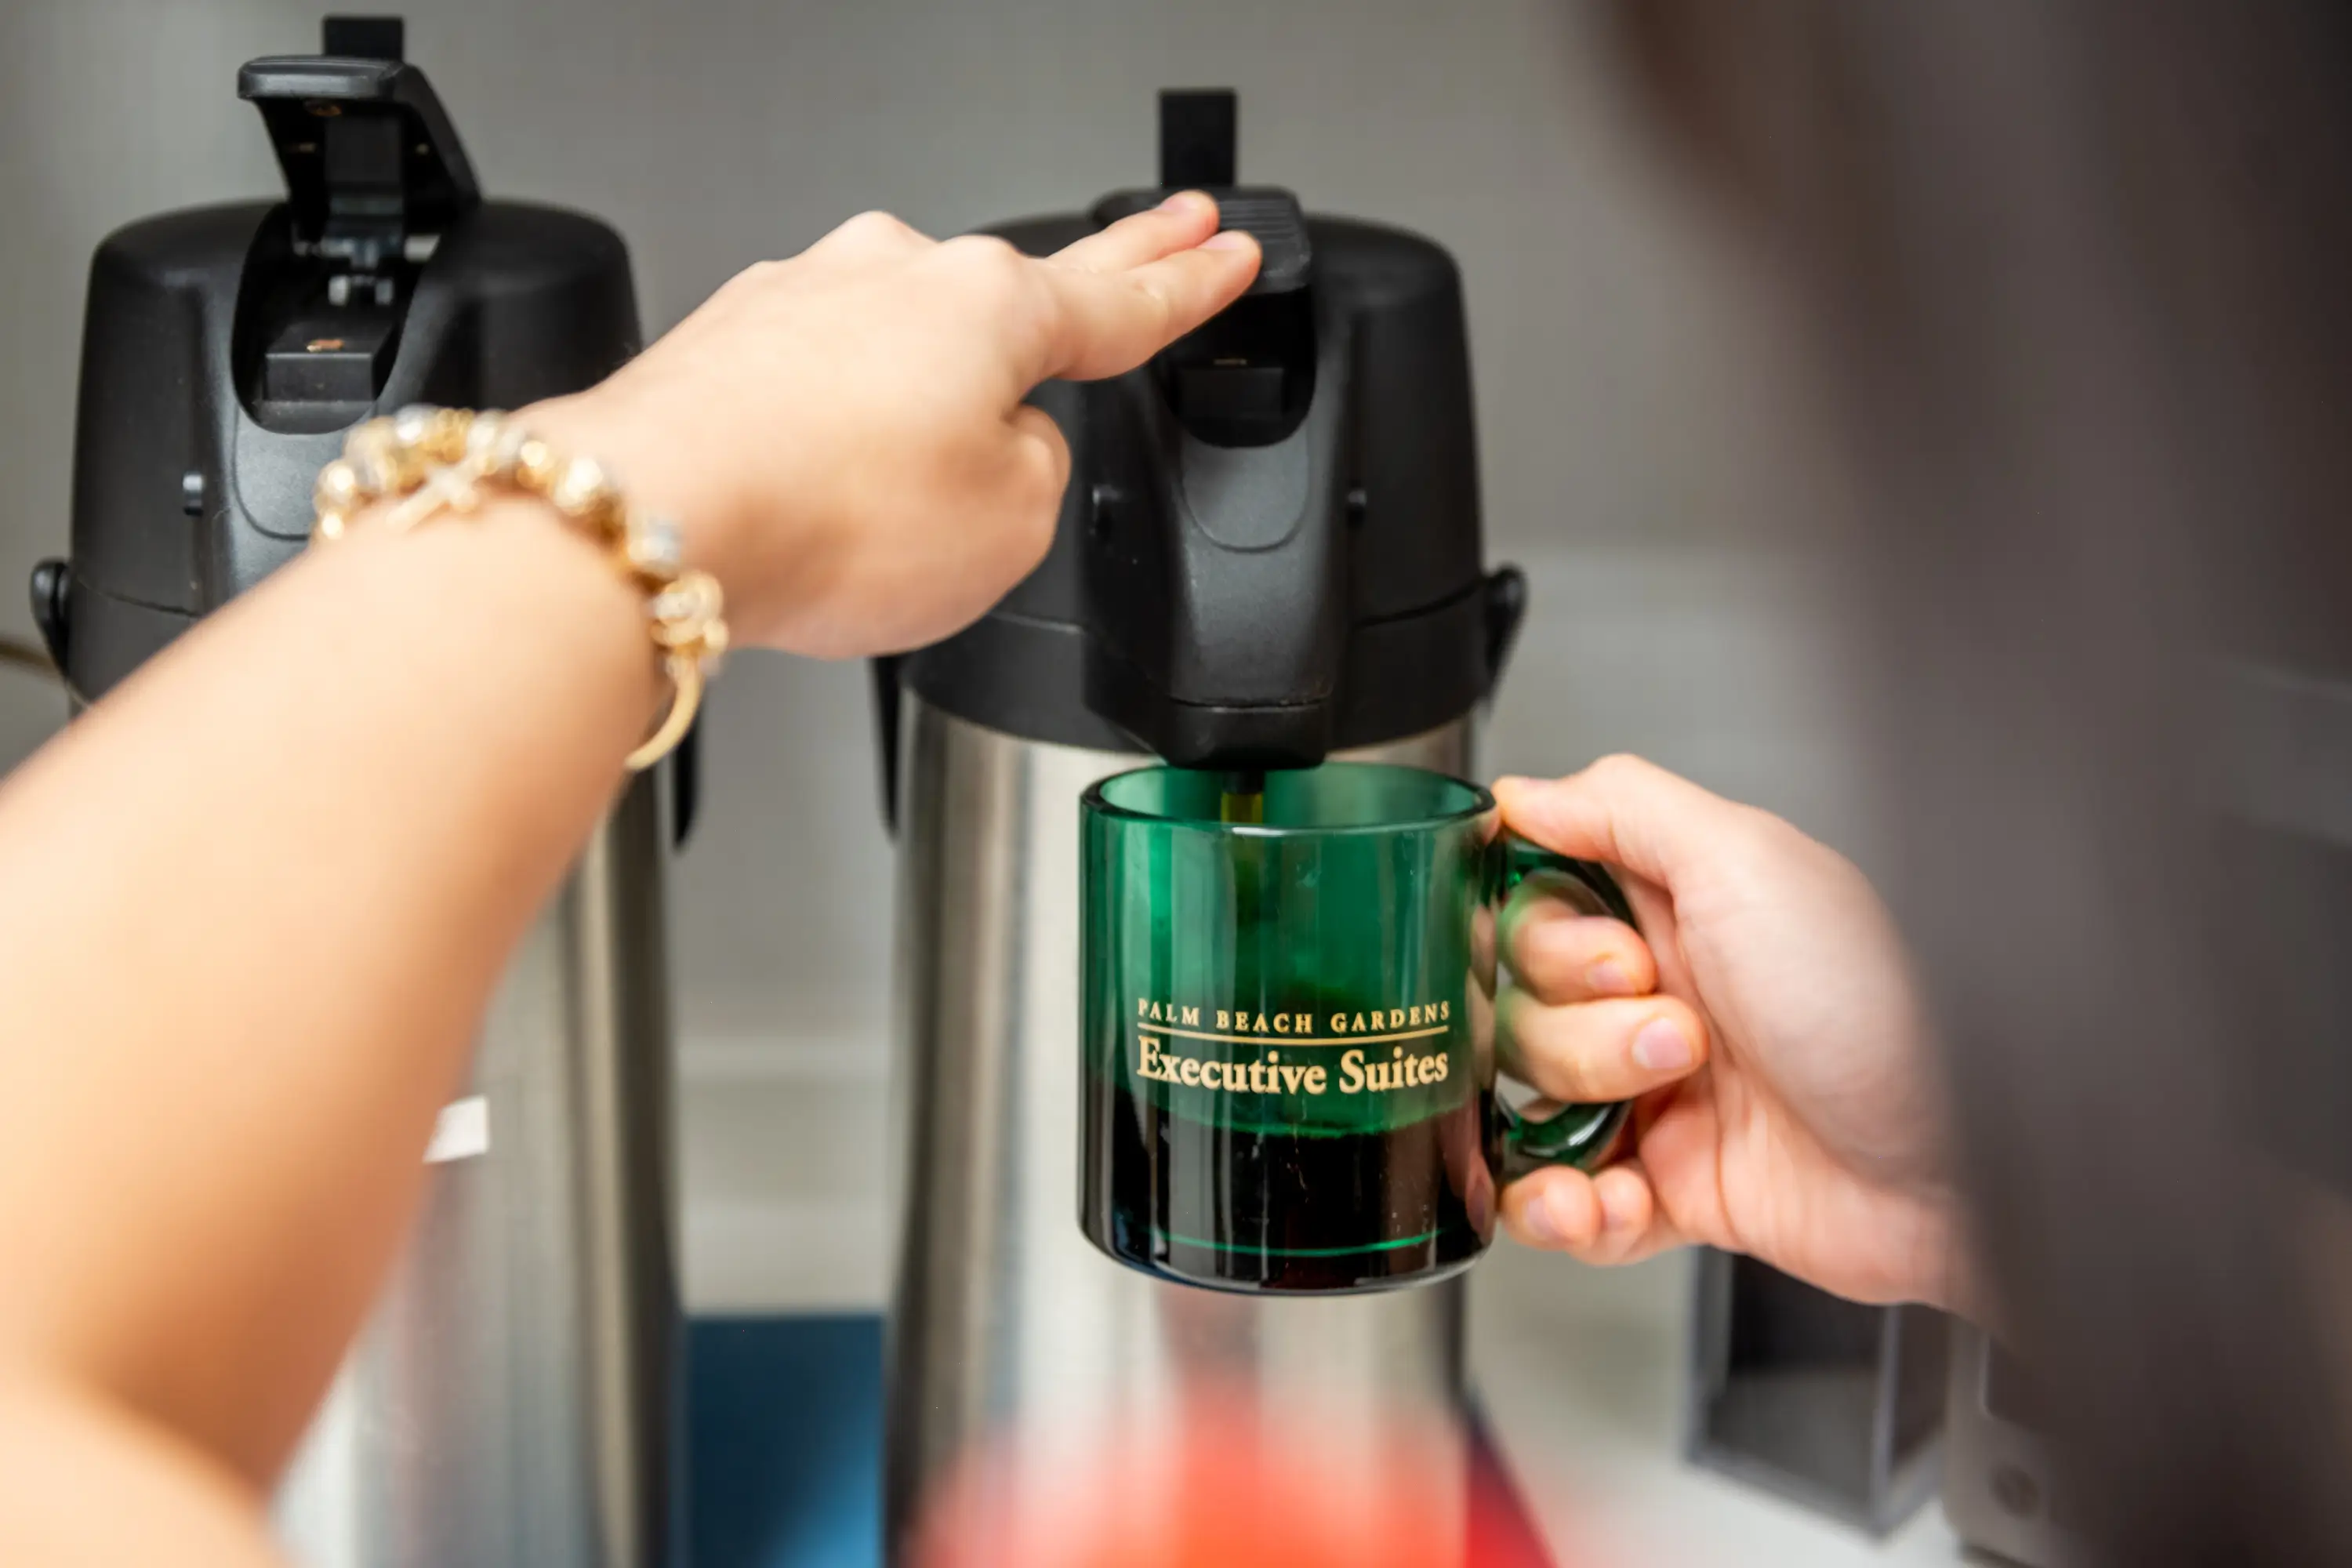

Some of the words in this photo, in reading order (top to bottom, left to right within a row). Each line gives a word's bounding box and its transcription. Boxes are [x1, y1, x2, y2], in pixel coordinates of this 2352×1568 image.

[1138, 998, 1200, 1026] PALM
[1216, 1009, 1313, 1033] BEACH
[1330, 1000, 1450, 1033] GARDENS
[1137, 1036, 1327, 1095] Executive
[1339, 1046, 1449, 1094] Suites
